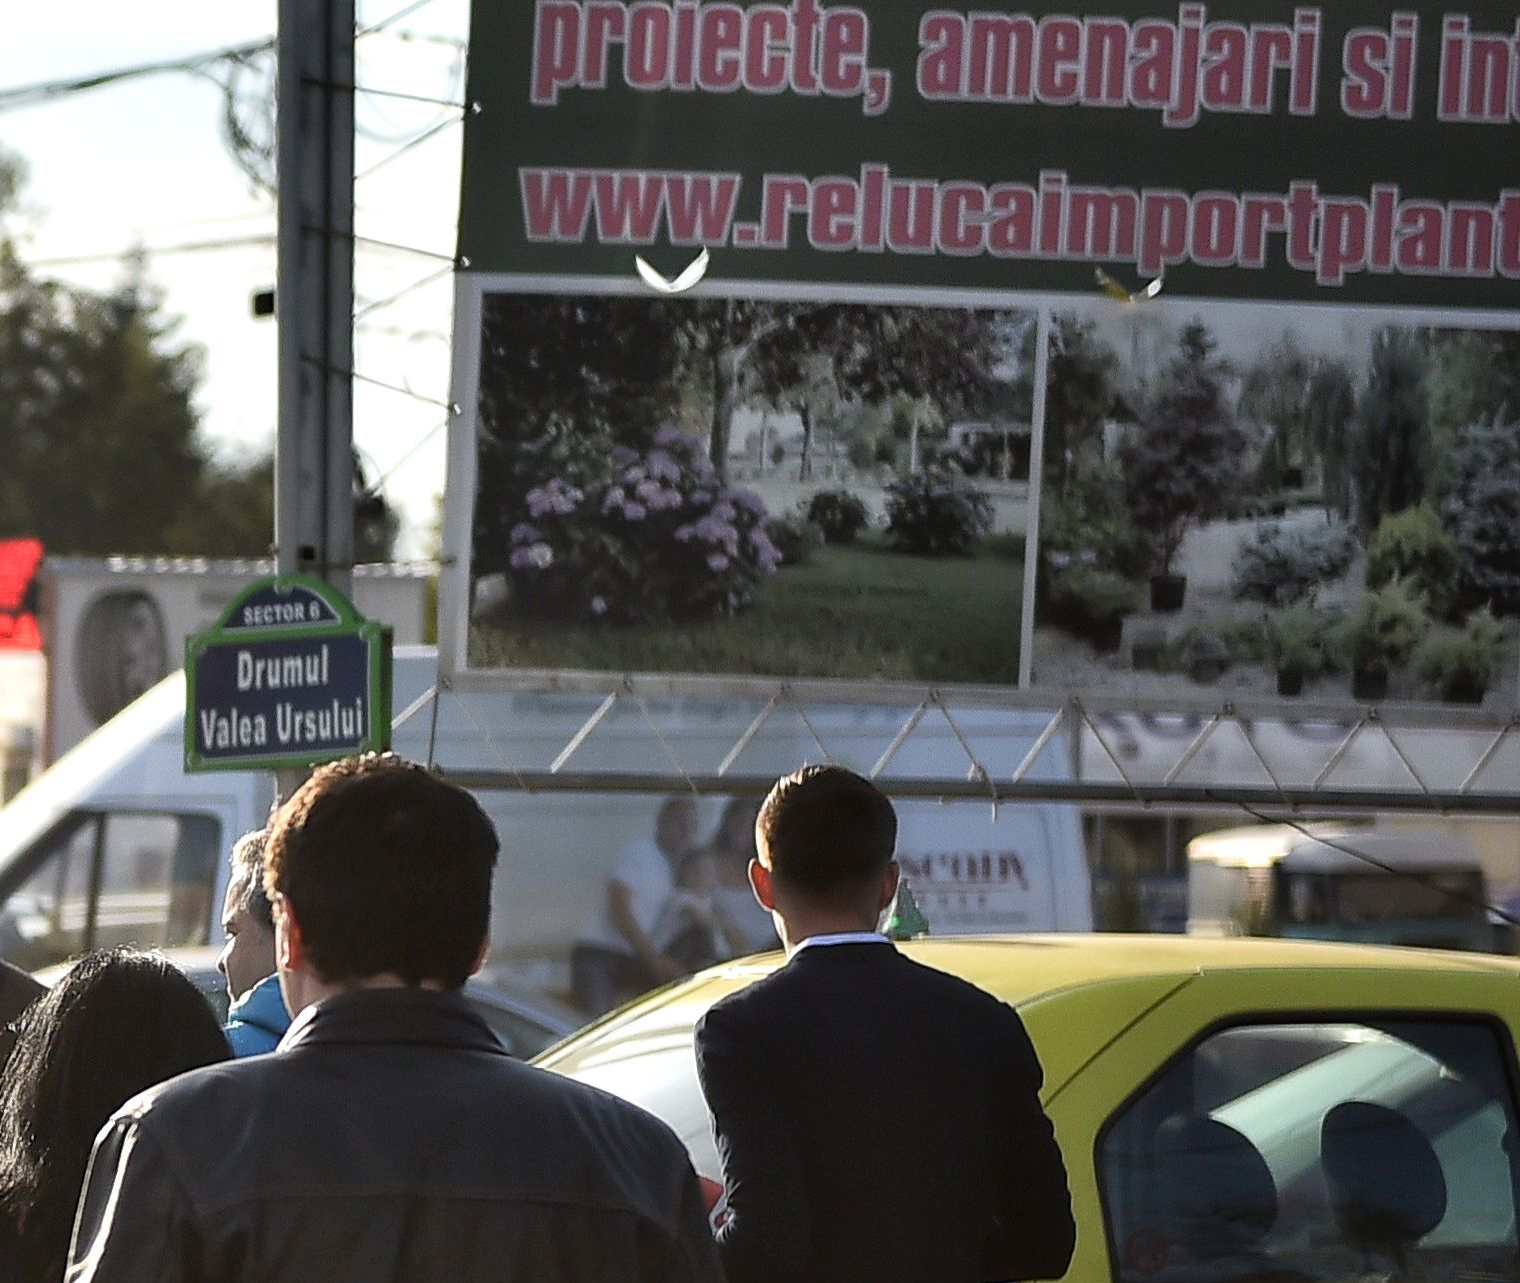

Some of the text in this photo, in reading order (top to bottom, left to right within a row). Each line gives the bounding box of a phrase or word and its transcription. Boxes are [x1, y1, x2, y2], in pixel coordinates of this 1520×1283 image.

[917, 3, 1321, 128] amenajari
[1341, 11, 1418, 119] si
[1437, 14, 1520, 124] in
[243, 601, 321, 624] SECTOR 6
[237, 645, 329, 691] Drumul
[201, 697, 363, 750] Valea Ursului
